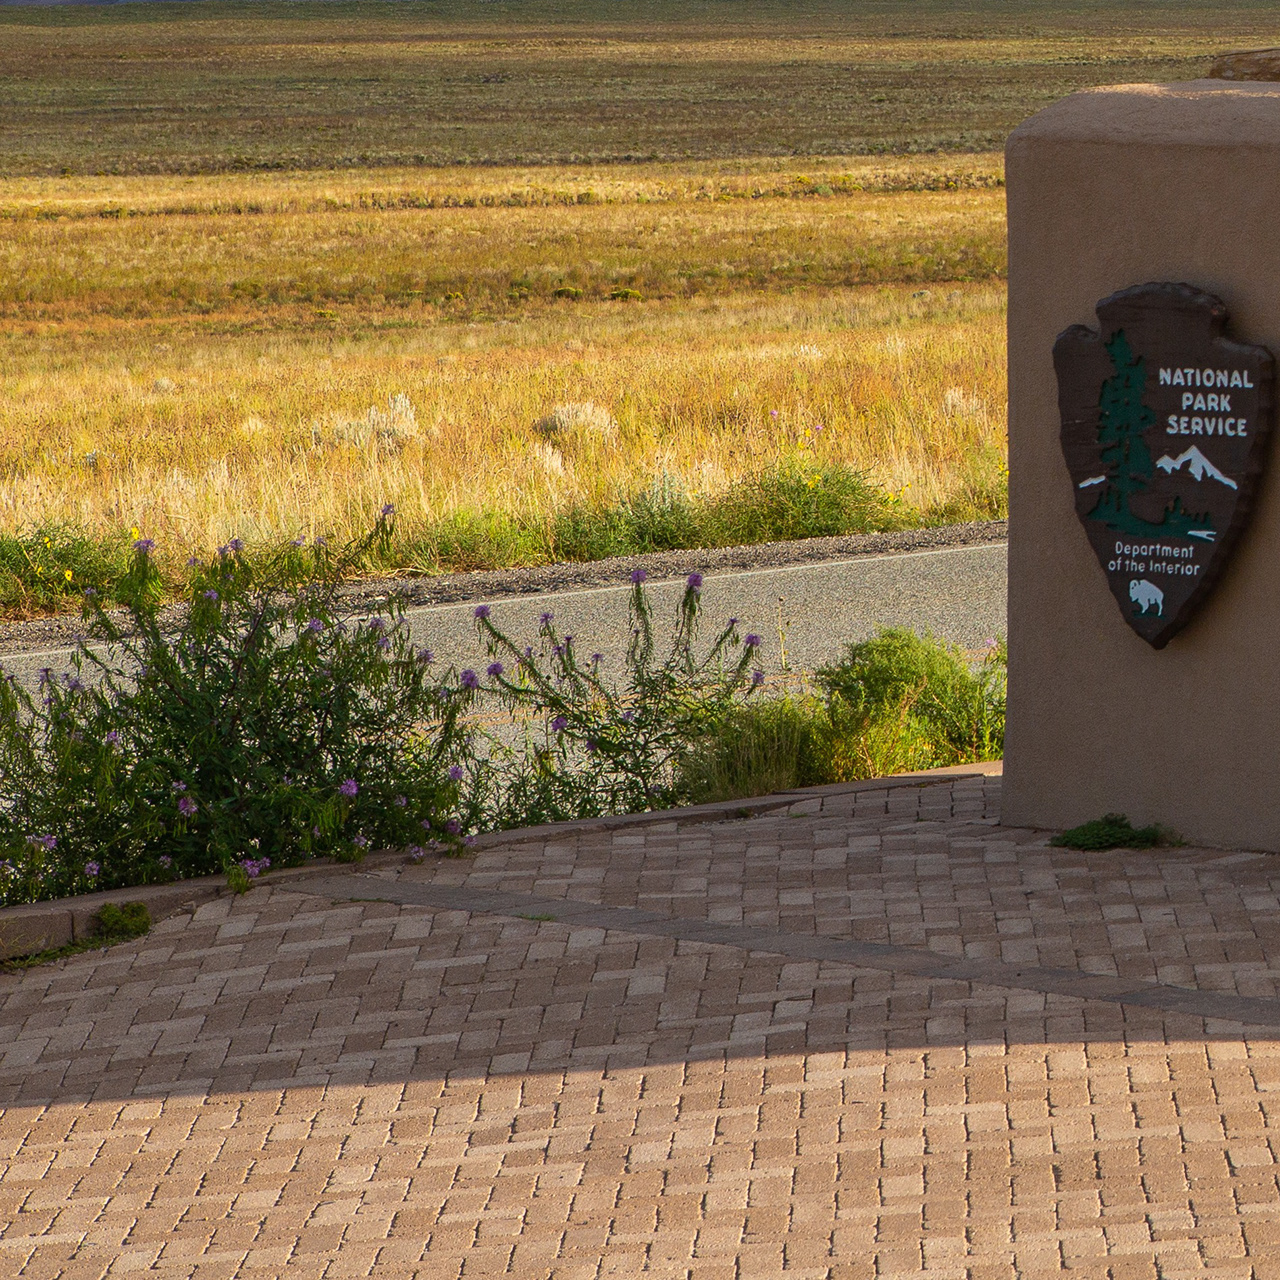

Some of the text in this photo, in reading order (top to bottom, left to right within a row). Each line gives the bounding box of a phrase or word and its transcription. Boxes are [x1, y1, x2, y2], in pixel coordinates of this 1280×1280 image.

[1159, 368, 1253, 388] NATIONAL
[1182, 392, 1231, 411] PARK
[1166, 415, 1247, 436] SERVICE
[1116, 541, 1194, 558] Department
[1108, 557, 1200, 575] of the Interior
